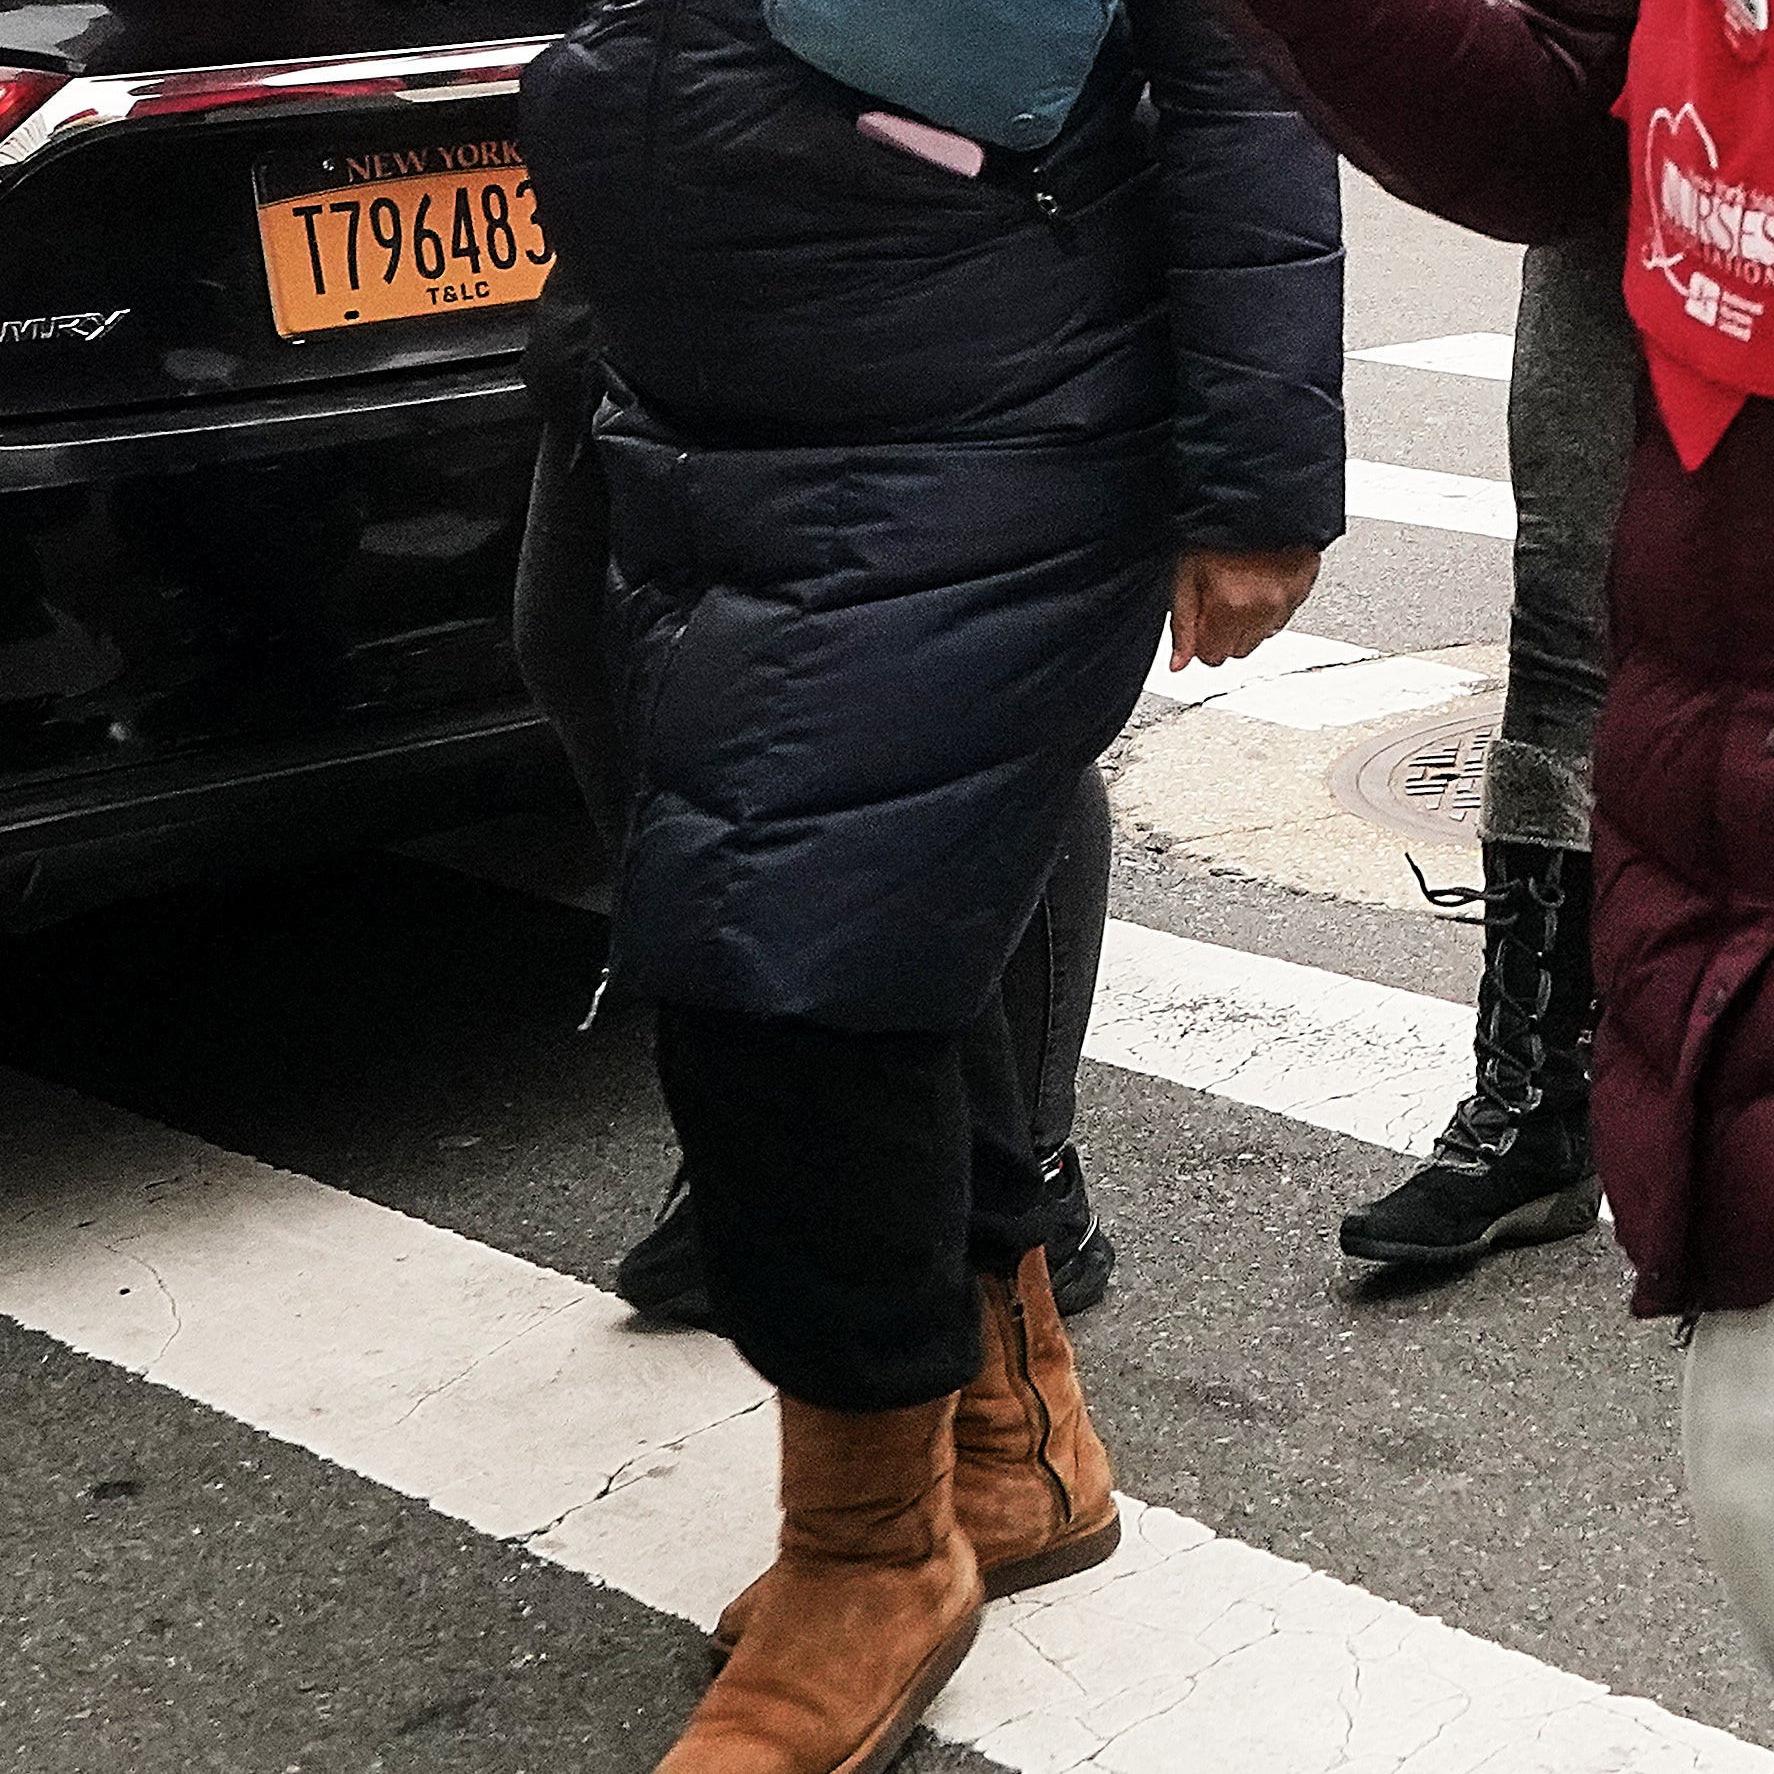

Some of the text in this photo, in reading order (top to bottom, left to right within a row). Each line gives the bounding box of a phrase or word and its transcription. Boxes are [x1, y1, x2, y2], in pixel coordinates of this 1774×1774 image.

[348, 139, 526, 183] NEW YORK
[292, 179, 557, 295] T796483
[426, 279, 491, 305] T&LC
